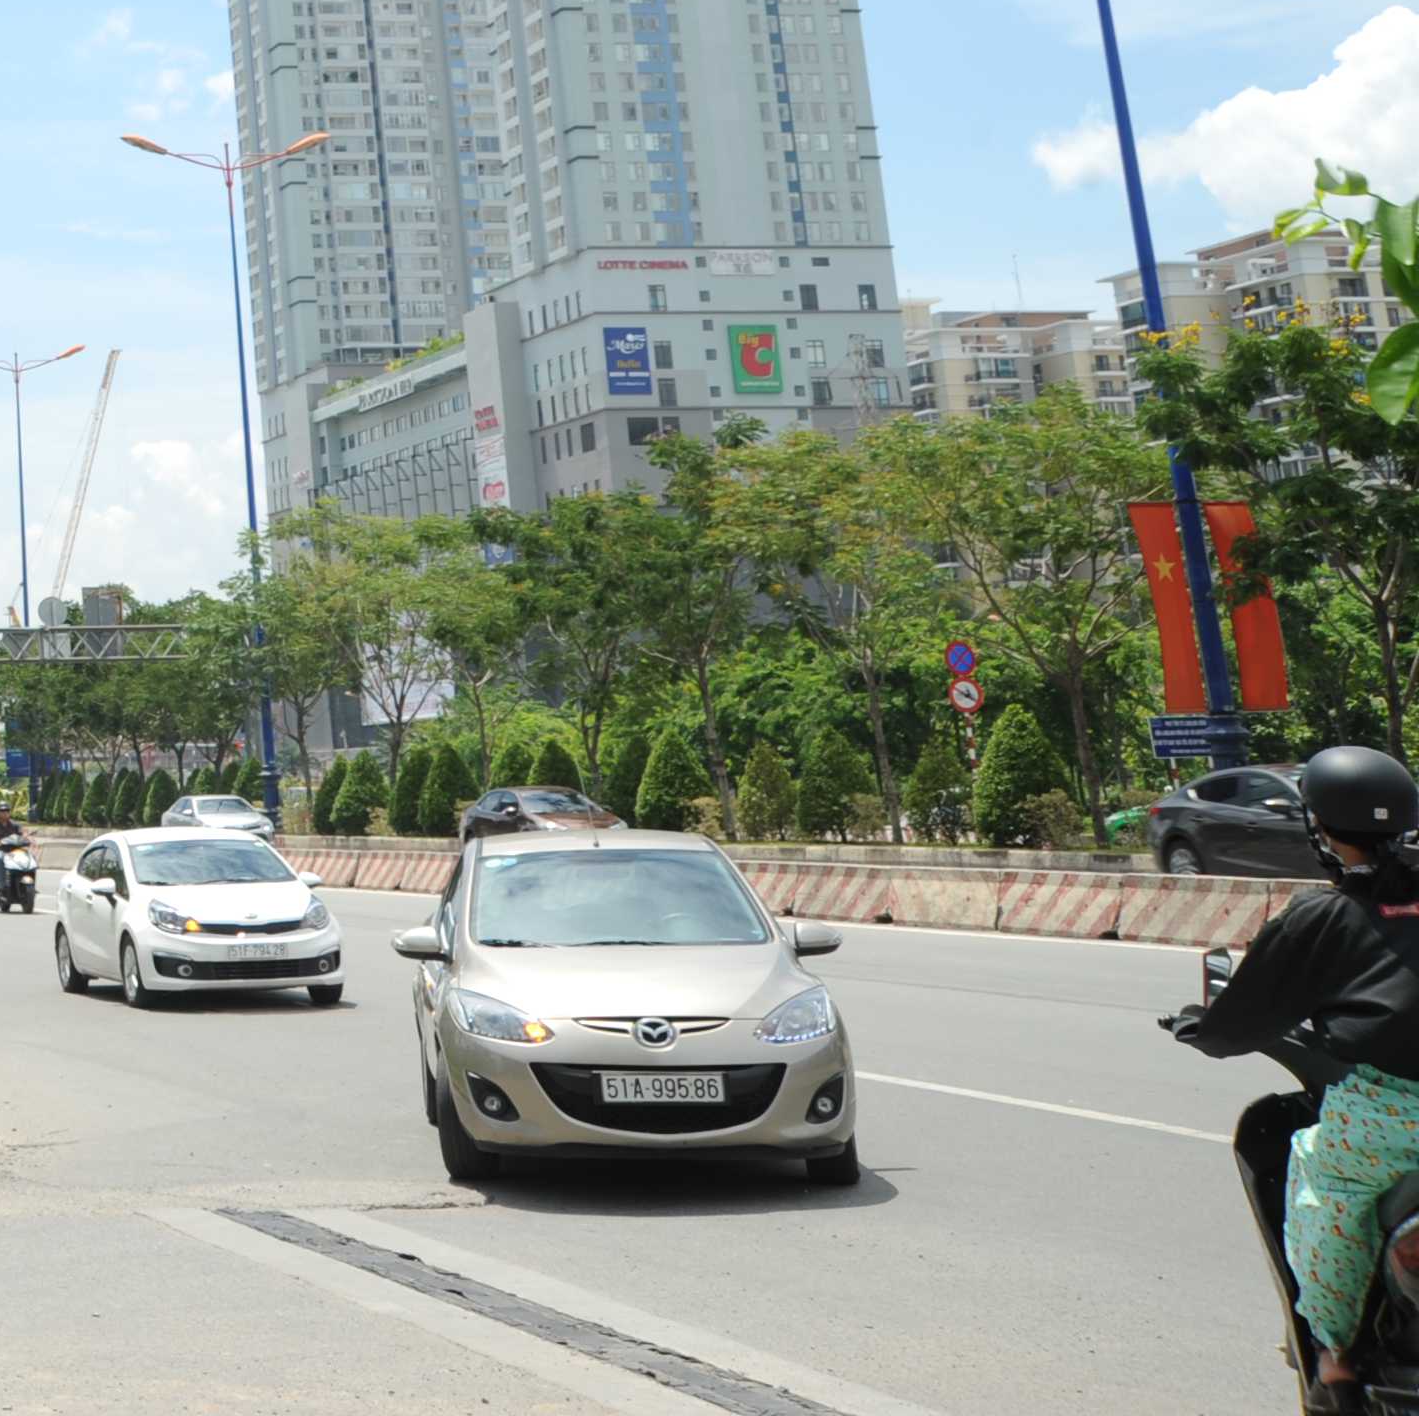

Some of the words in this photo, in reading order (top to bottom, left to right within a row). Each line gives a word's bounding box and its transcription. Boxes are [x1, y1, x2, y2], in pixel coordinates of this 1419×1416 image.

[597, 260, 636, 270] LOTTE
[738, 332, 760, 348] Big
[740, 334, 775, 379] C
